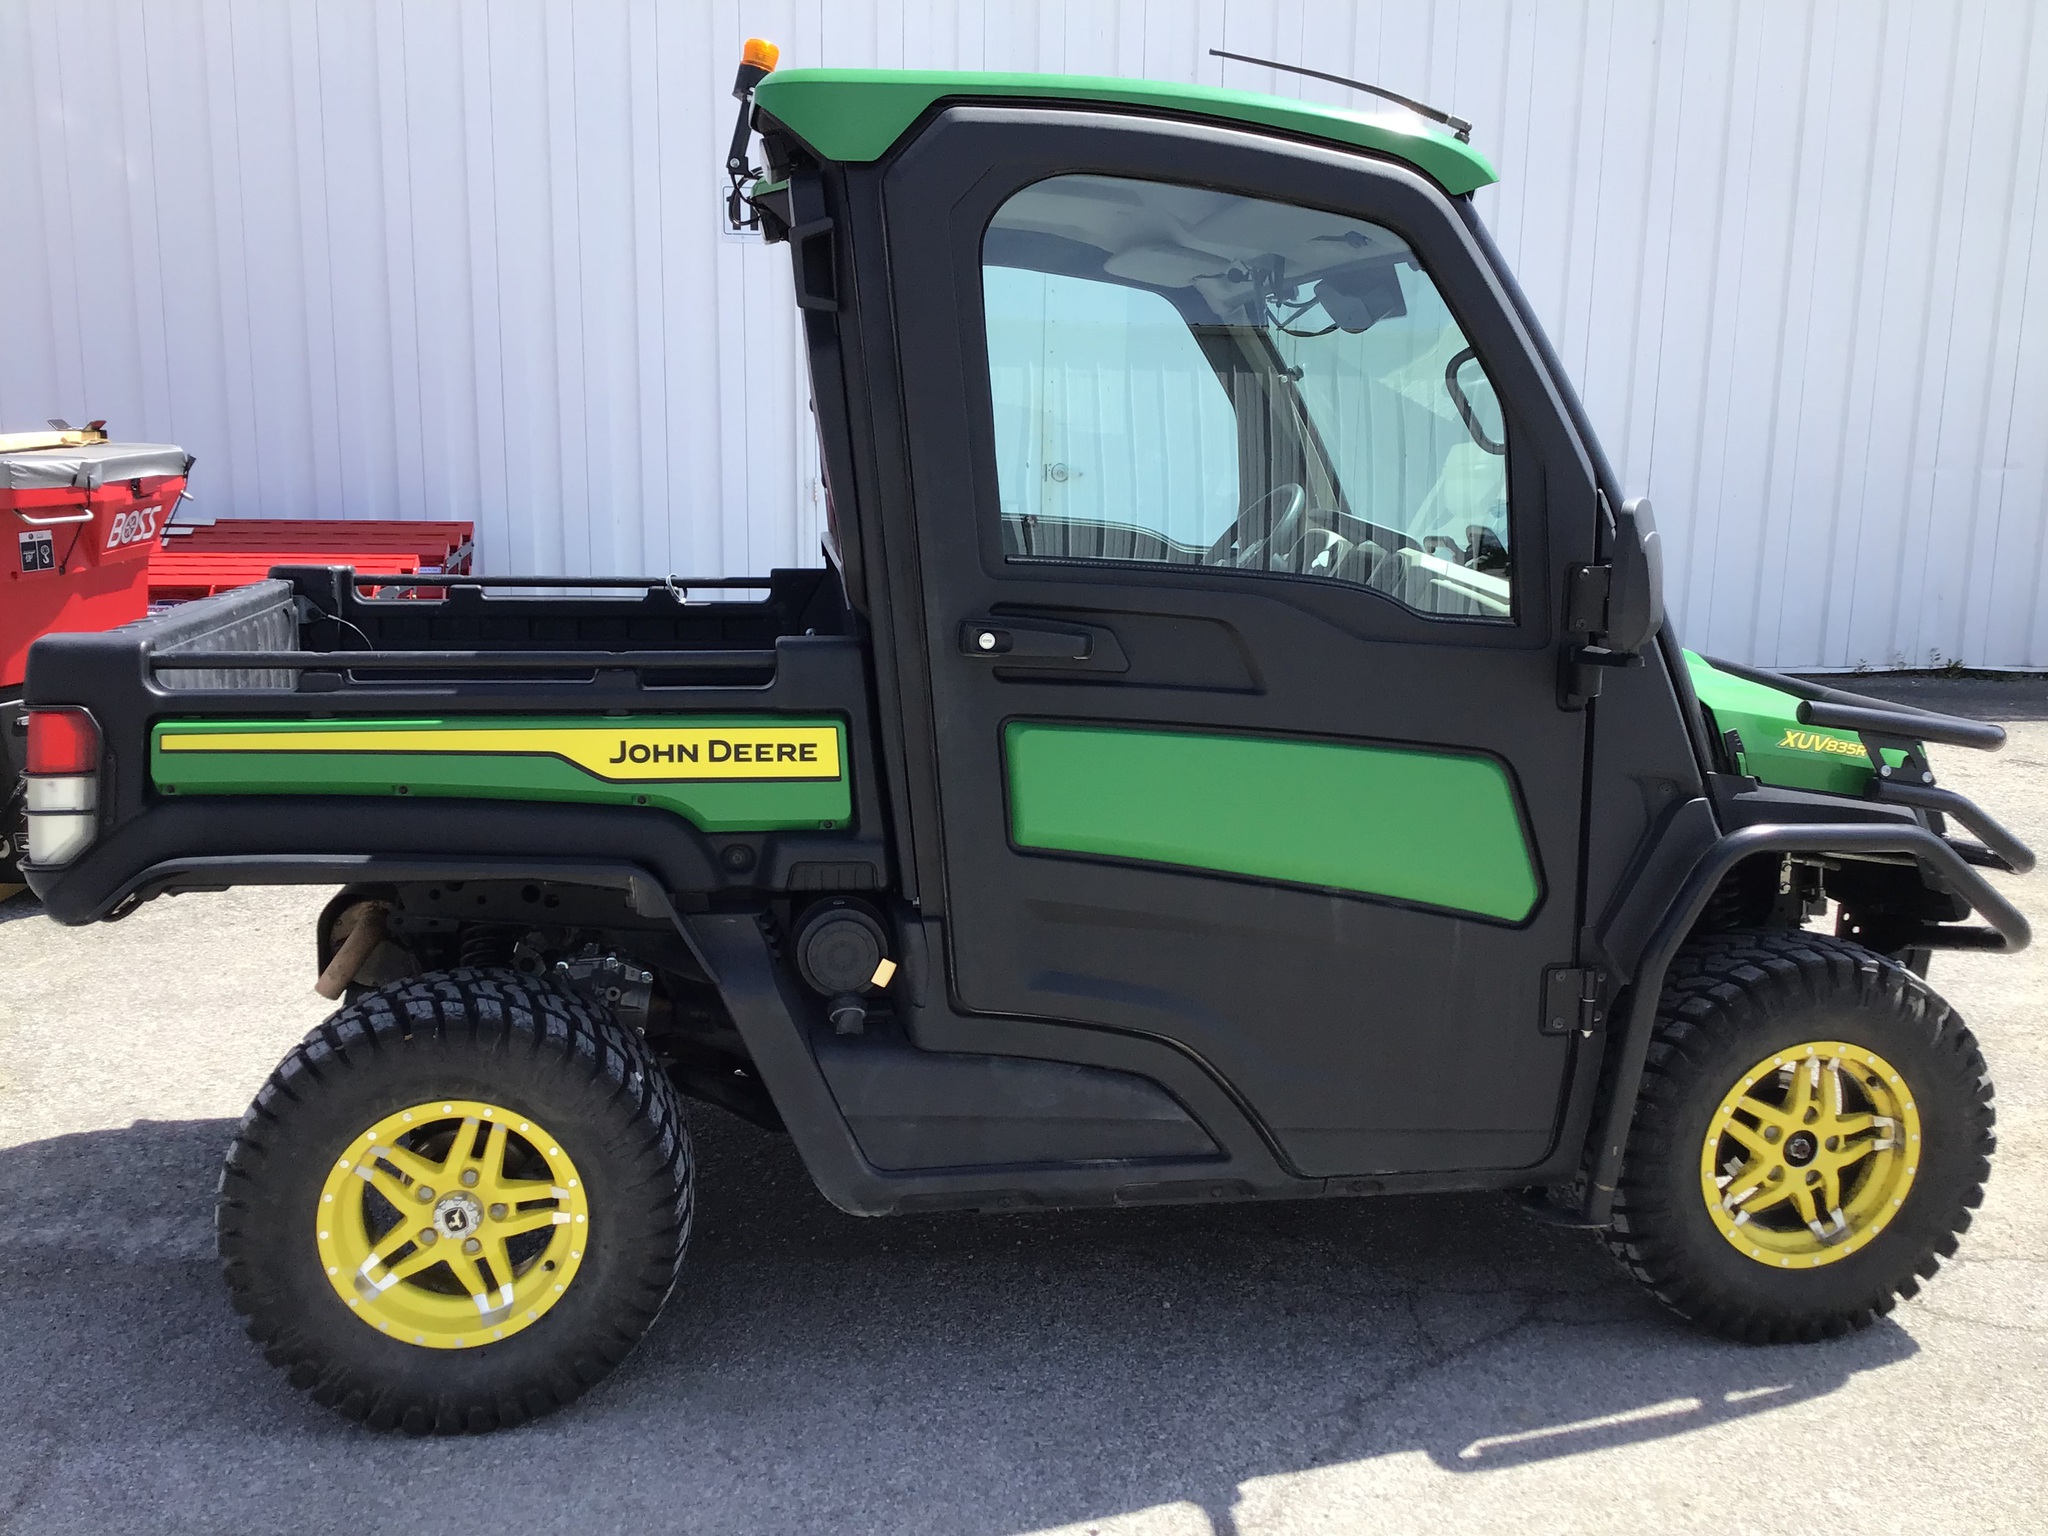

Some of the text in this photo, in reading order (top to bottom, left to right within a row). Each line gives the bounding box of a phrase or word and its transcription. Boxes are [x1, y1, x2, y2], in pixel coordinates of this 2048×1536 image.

[106, 505, 162, 548] BOSS
[609, 739, 818, 764] JOHN DEERE
[1780, 730, 1867, 757] XUV835R
